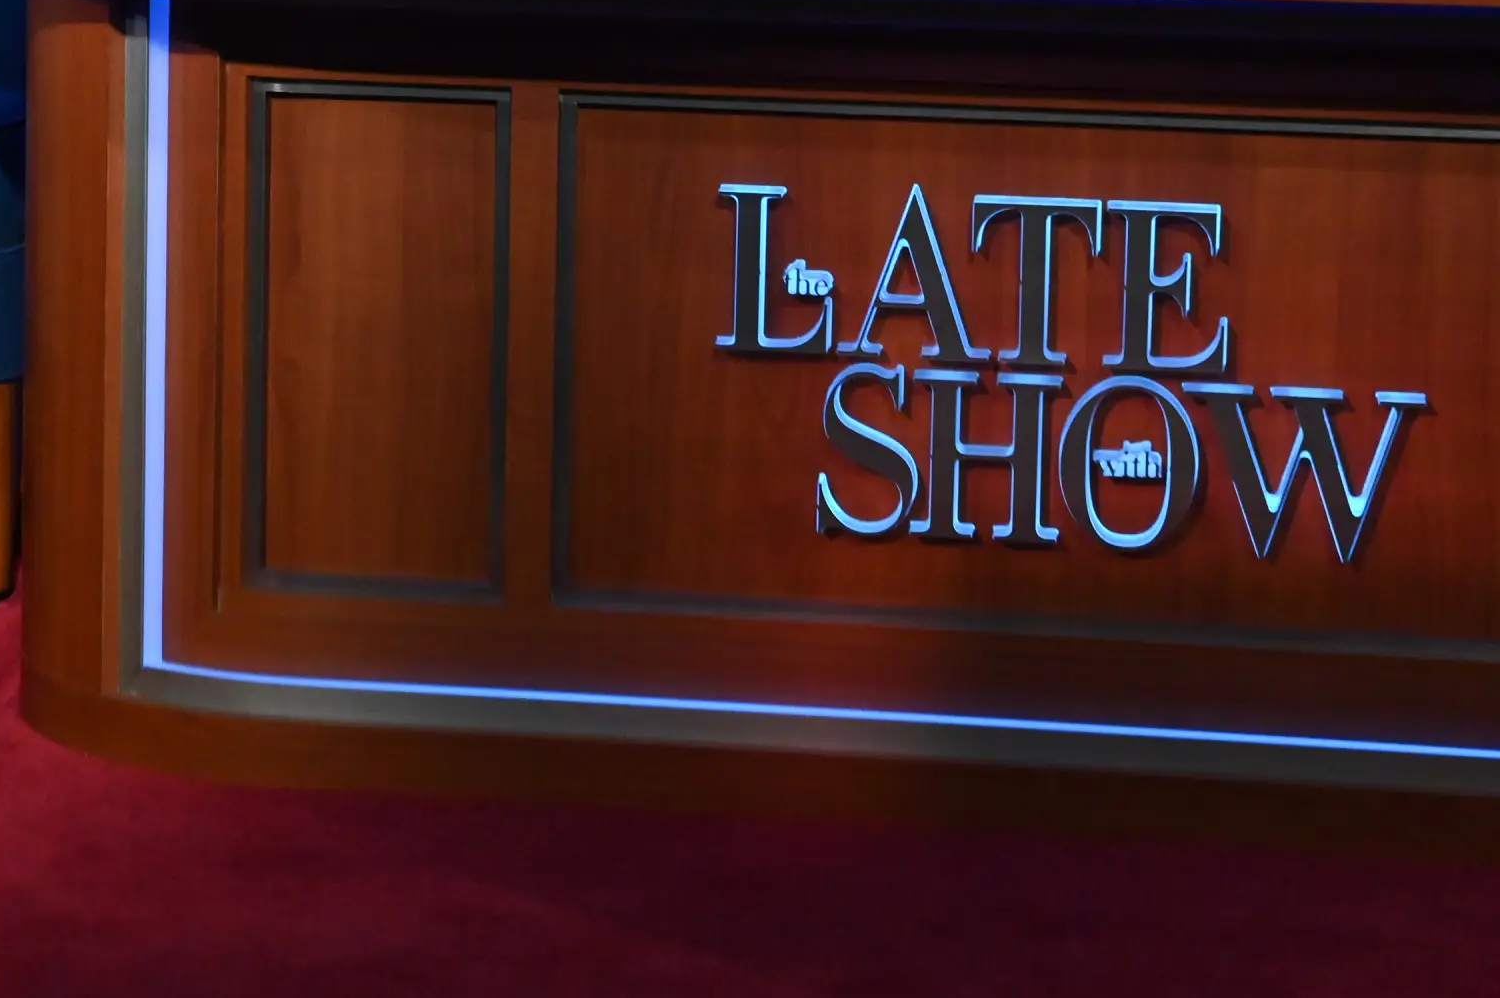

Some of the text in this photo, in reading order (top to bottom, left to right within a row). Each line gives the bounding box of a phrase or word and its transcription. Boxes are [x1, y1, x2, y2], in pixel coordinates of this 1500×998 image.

[714, 182, 1231, 376] LATE
[783, 258, 834, 297] the
[815, 362, 1429, 564] SHOW
[1093, 440, 1163, 479] with
